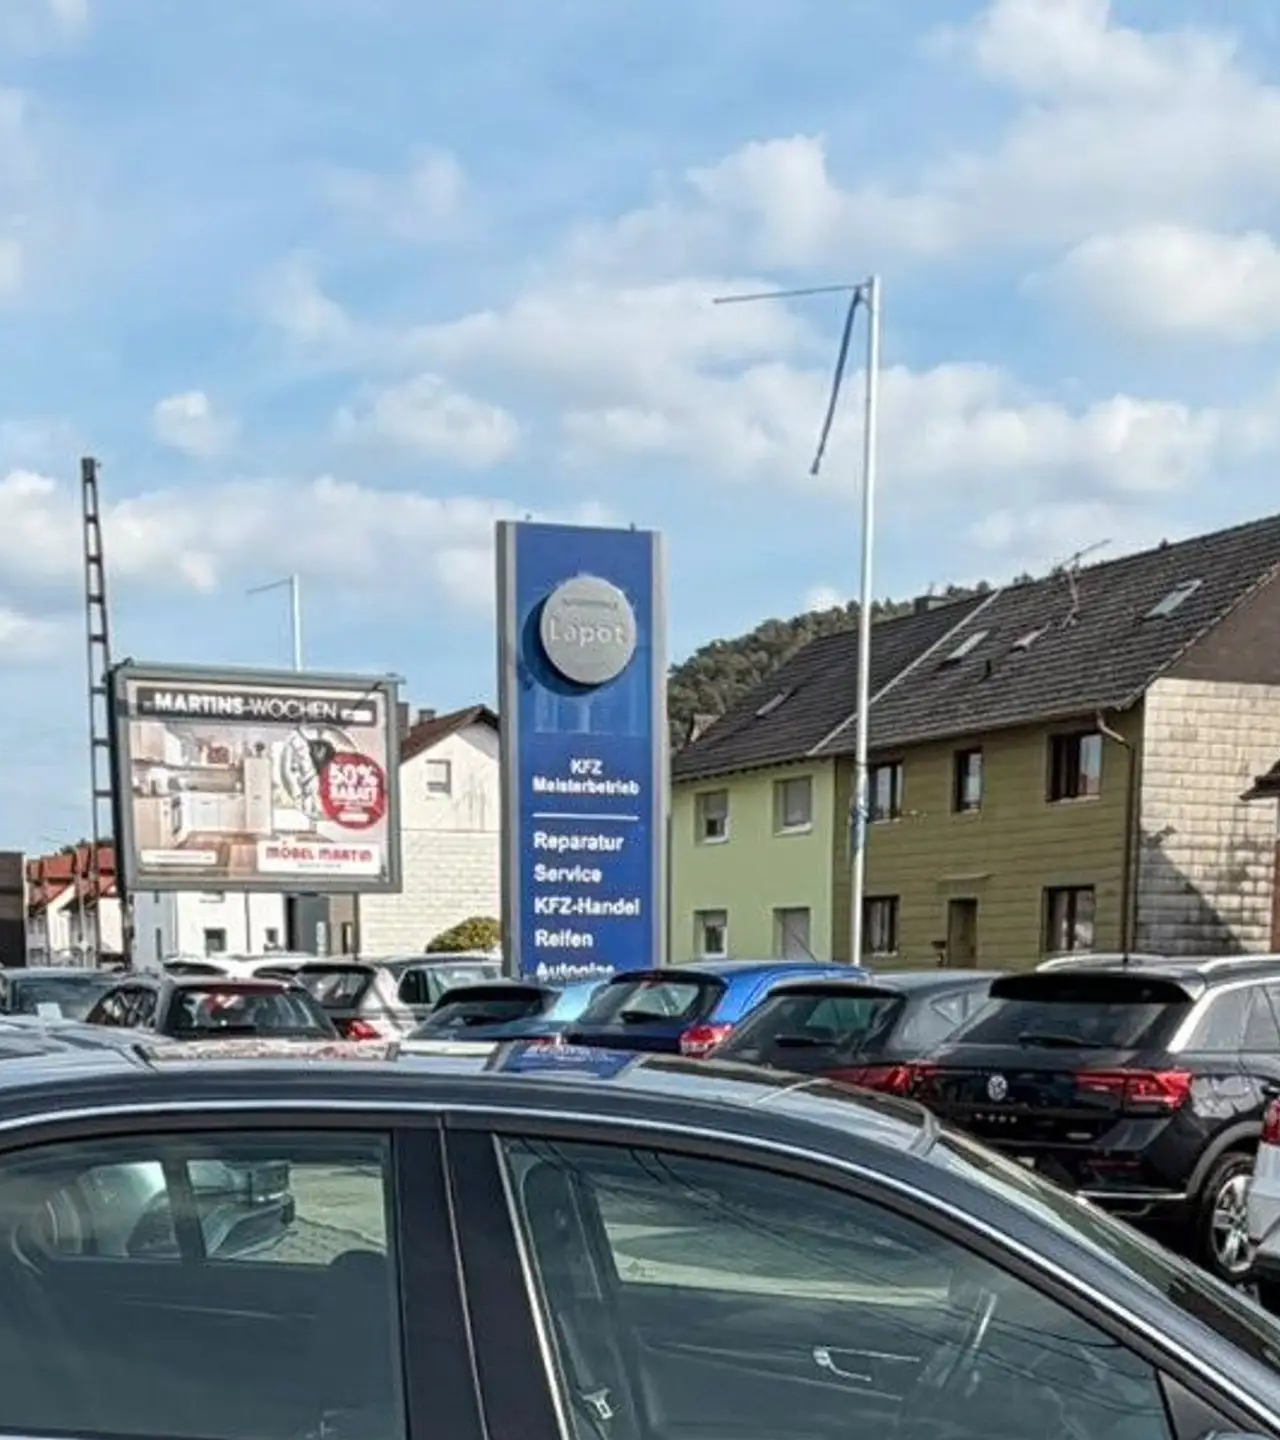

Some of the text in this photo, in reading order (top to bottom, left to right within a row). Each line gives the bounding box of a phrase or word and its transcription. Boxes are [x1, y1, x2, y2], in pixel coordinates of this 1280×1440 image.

[549, 617, 625, 647] Lapot
[154, 691, 338, 720] MARTINS-WOCHEN
[570, 758, 603, 775] KFZ
[532, 775, 640, 796] Meisterbetrieb
[533, 831, 624, 853] Reparatur
[533, 864, 603, 884] Service
[533, 896, 641, 916] KFZ-Handel
[534, 928, 594, 948] Reifen
